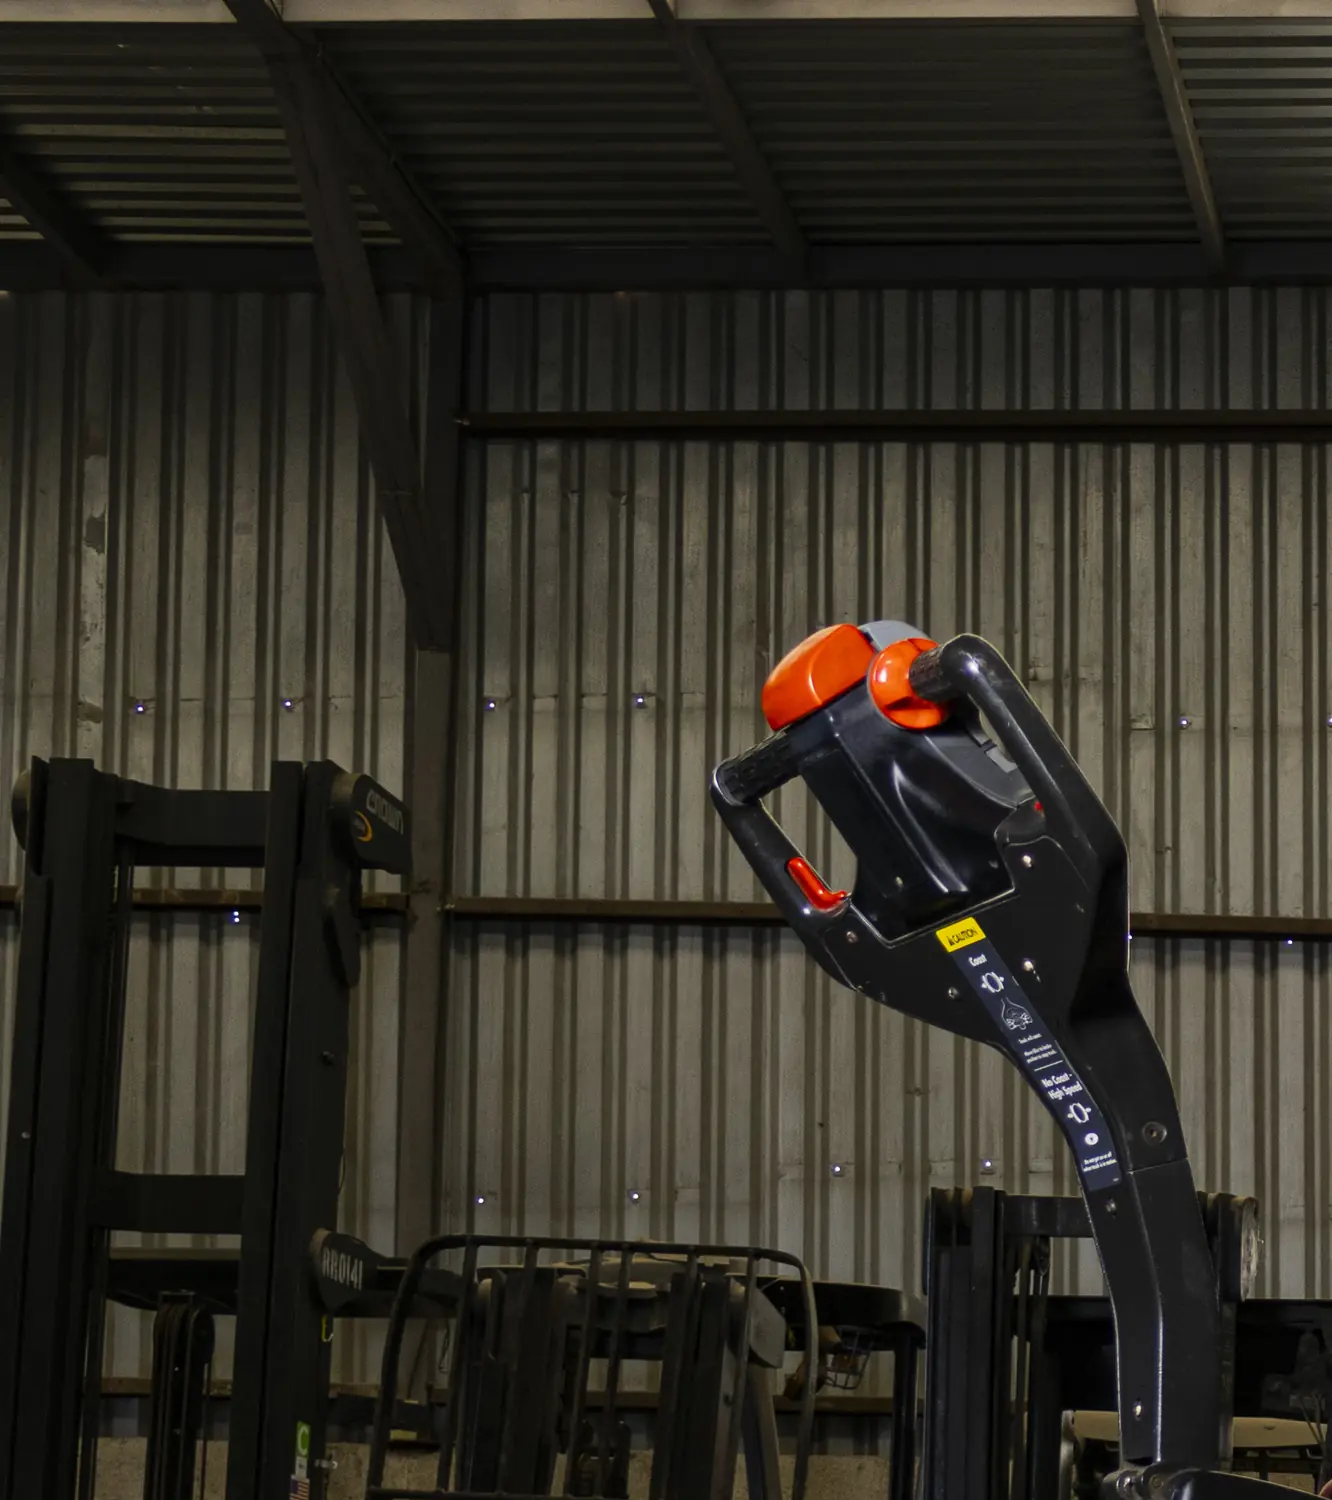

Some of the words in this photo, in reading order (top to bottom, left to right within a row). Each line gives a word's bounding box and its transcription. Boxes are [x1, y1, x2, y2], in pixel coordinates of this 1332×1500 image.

[951, 927, 980, 944] CAUTION
[968, 953, 988, 967] Coast
[1041, 1078, 1054, 1088] No
[1051, 1072, 1070, 1085] Coast
[1047, 1087, 1065, 1101] High
[1062, 1080, 1083, 1097] Speed
